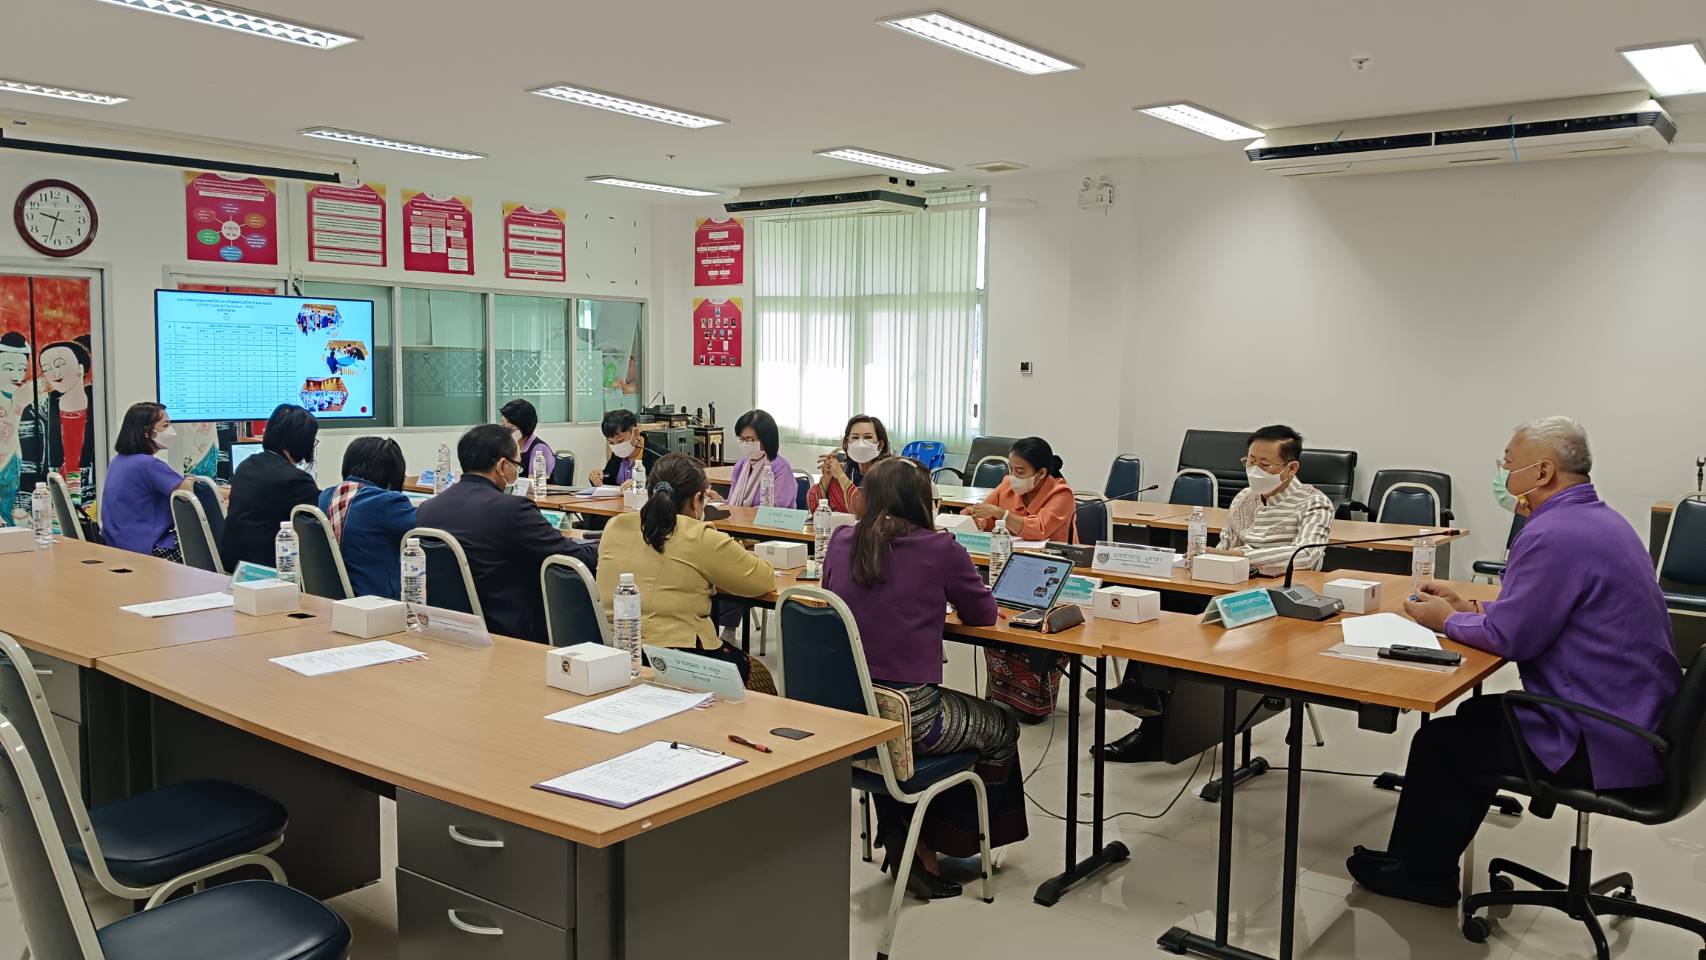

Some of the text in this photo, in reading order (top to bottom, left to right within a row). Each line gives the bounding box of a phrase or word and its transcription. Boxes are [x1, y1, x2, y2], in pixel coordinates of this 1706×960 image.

[40, 193, 47, 202] 11
[50, 190, 60, 199] 12
[30, 201, 40, 210] 10
[74, 204, 81, 213] 2
[78, 216, 86, 224] 3
[30, 225, 39, 233] 8
[76, 228, 81, 236] 4
[42, 234, 49, 243] 7
[66, 236, 74, 244] 5
